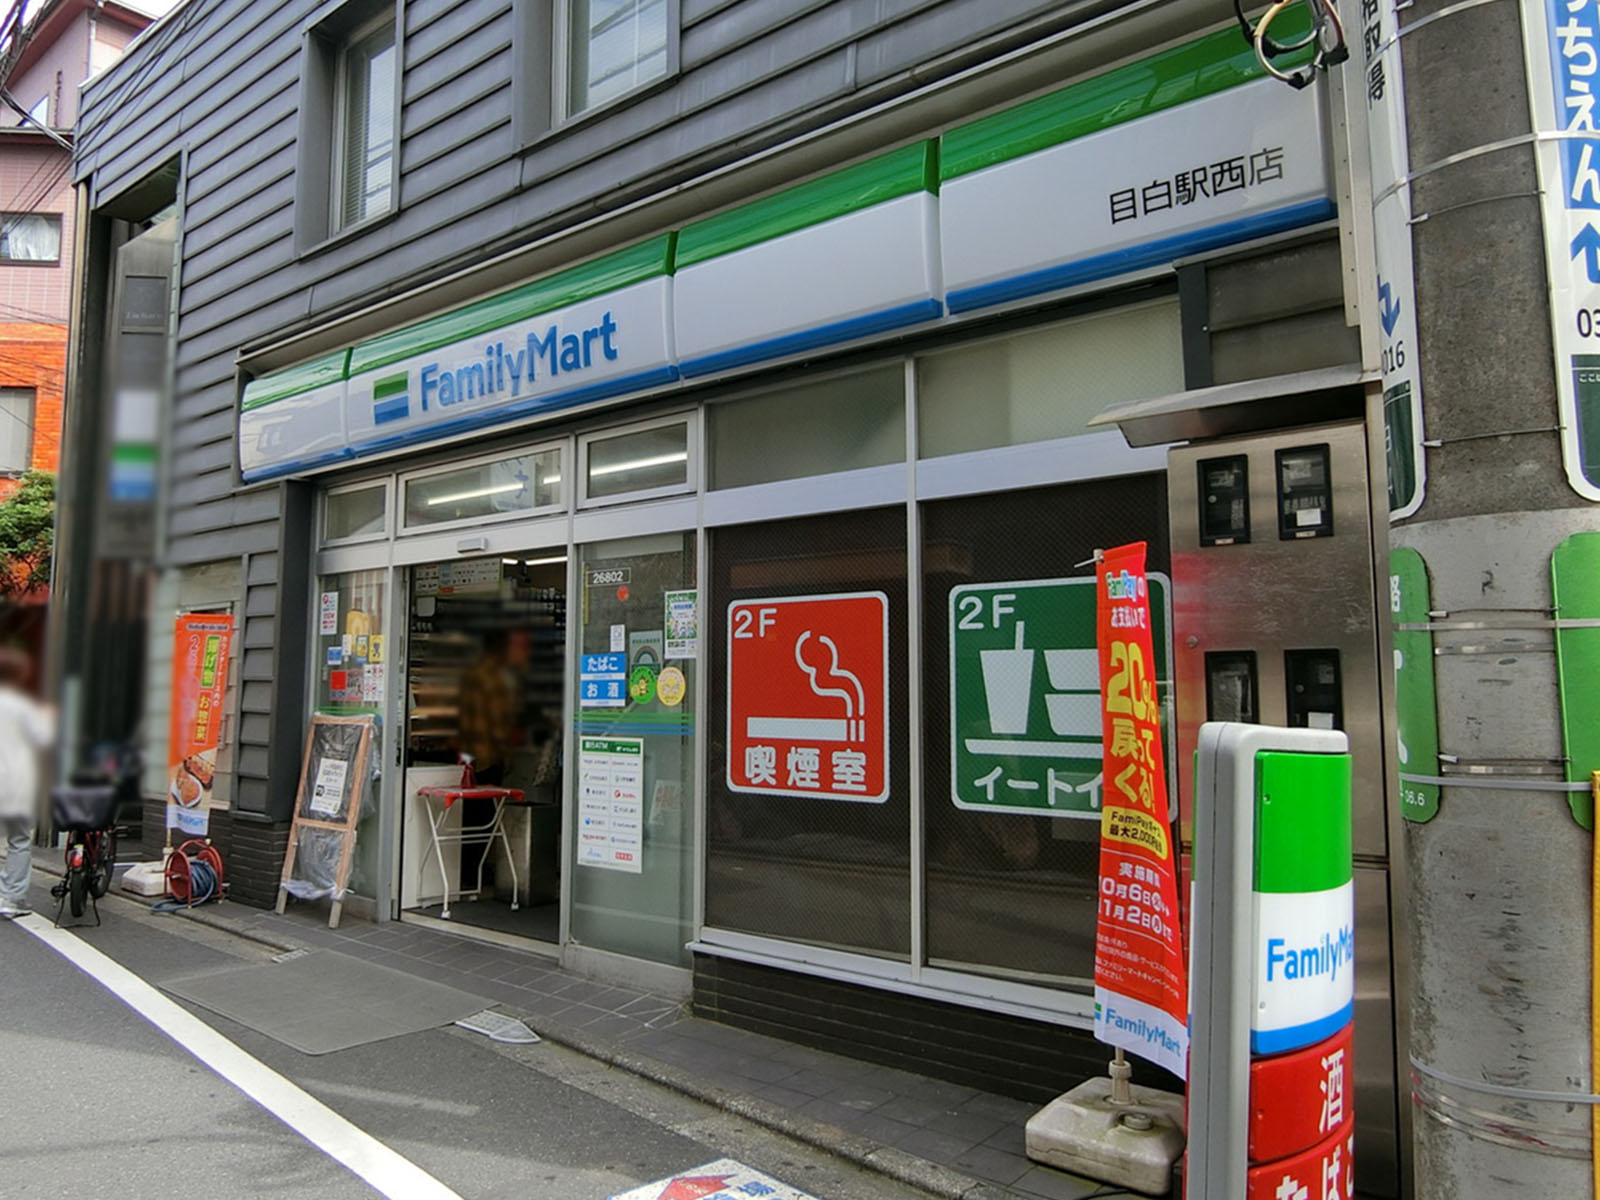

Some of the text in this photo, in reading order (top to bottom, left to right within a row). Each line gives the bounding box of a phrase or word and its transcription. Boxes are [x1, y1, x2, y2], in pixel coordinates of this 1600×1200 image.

[1109, 146, 1284, 225] 目白駅西店
[420, 310, 618, 412] FamilyMart
[592, 571, 624, 584] 26802
[734, 608, 777, 638] 2F
[958, 593, 1017, 629] 2F
[587, 656, 619, 672] たばこ
[744, 744, 867, 792] 喫煙室
[1110, 718, 1156, 770] 戻って
[1105, 1007, 1182, 1057] FamilyMart
[1319, 1048, 1344, 1134] 酒
